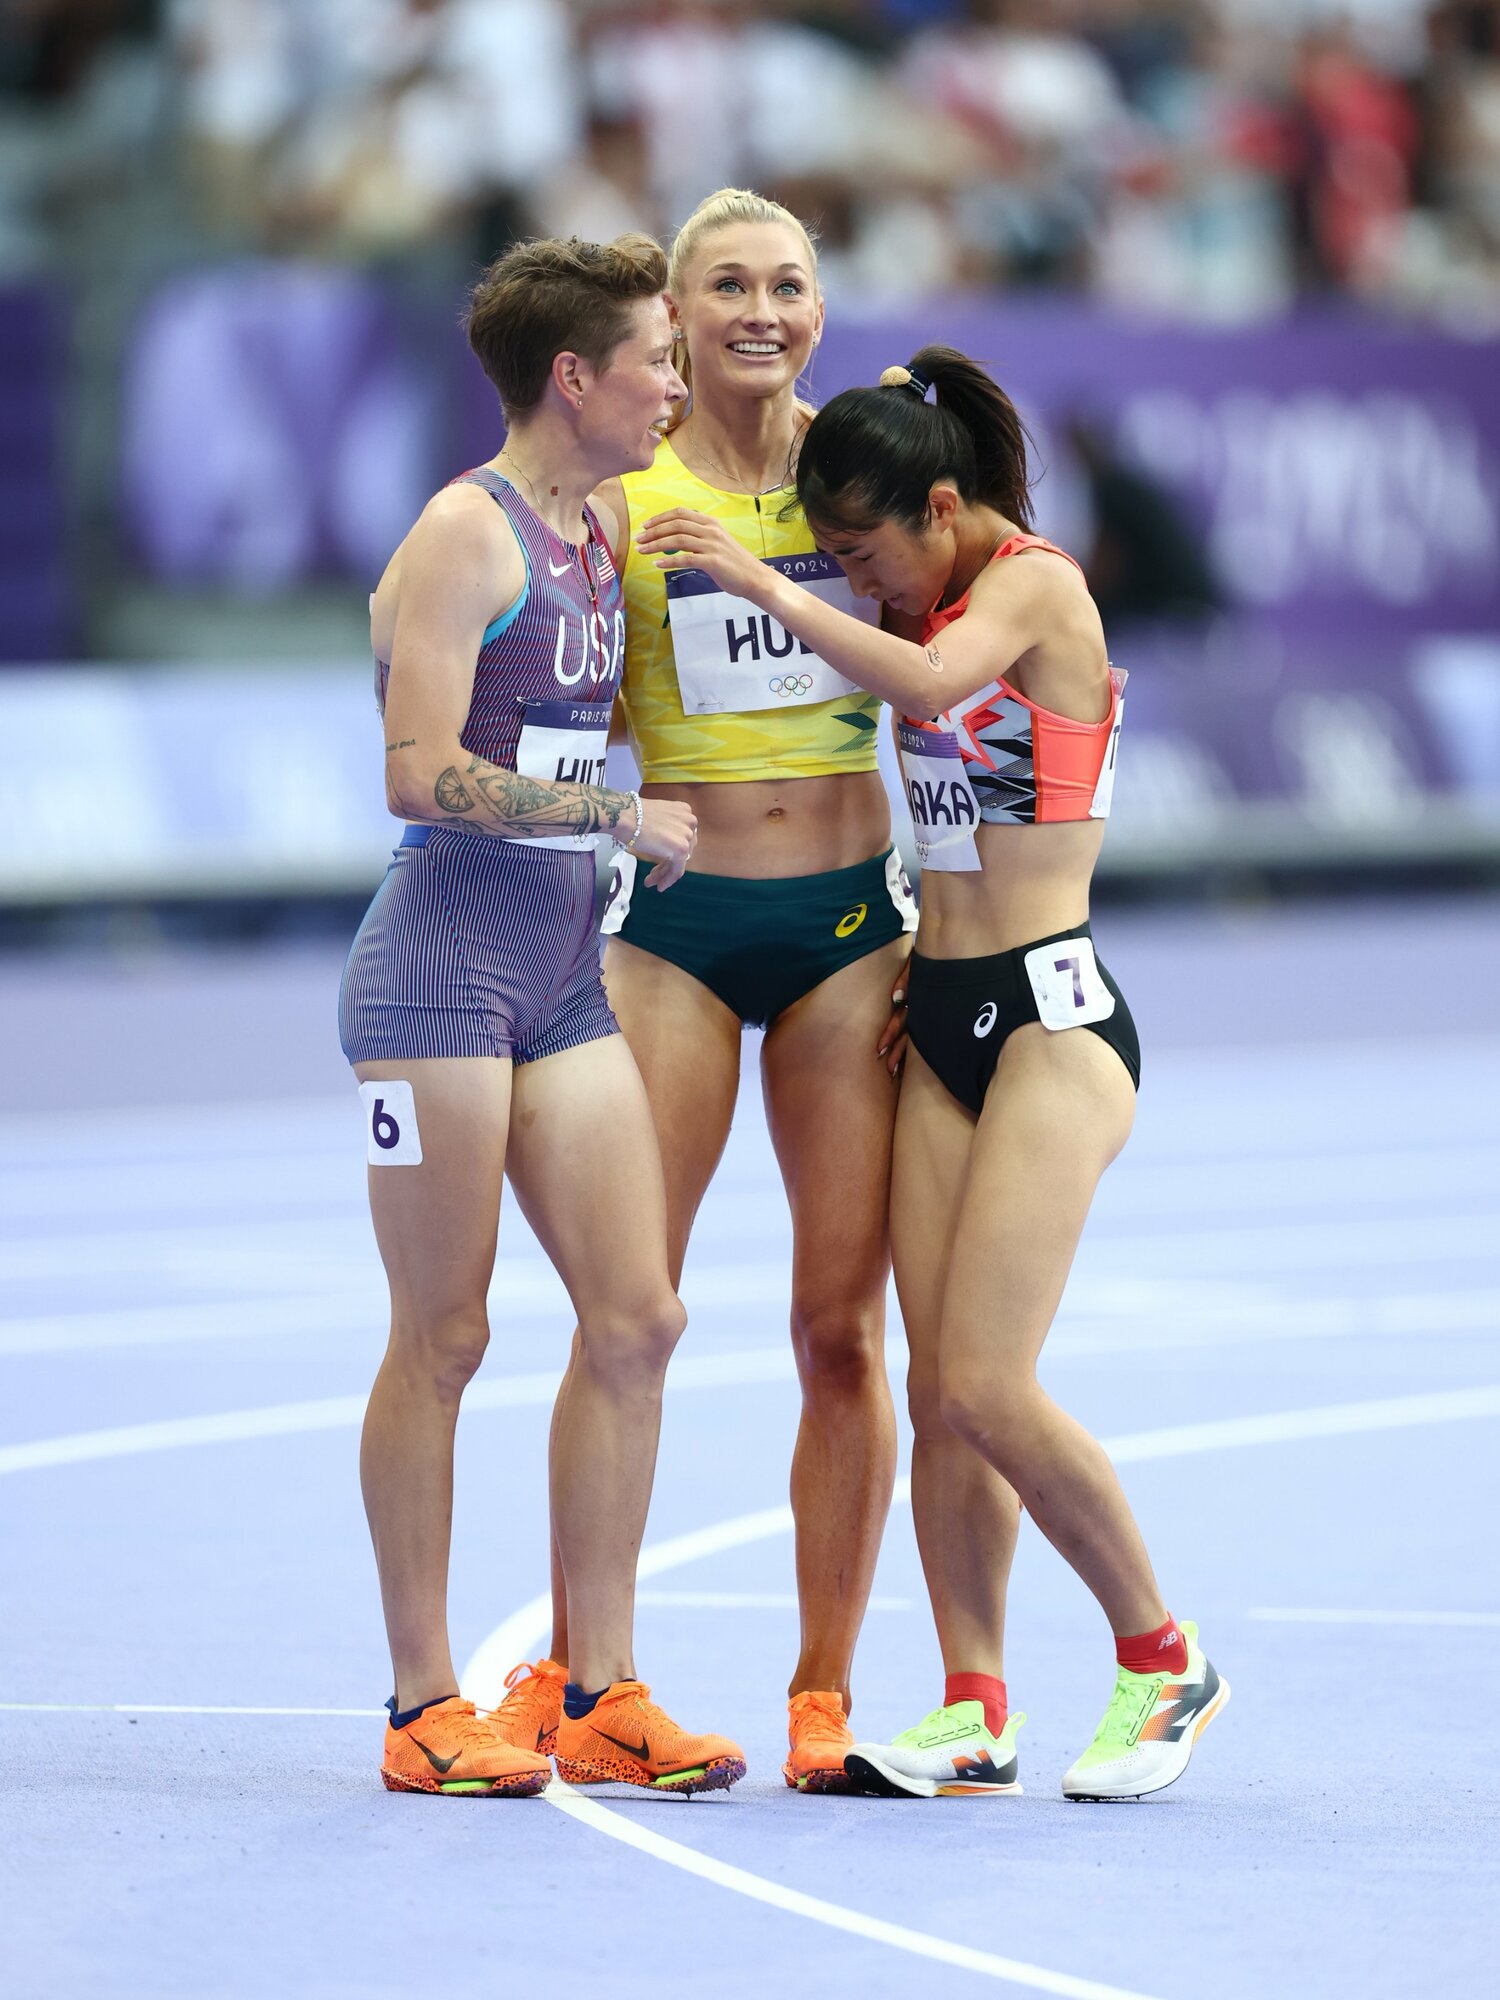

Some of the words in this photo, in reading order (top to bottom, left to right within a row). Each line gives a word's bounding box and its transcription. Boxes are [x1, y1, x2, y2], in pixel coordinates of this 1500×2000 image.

[554, 610, 626, 686] USA
[725, 614, 815, 663] HU
[1053, 956, 1086, 1008] 7
[371, 1098, 401, 1150] 6
